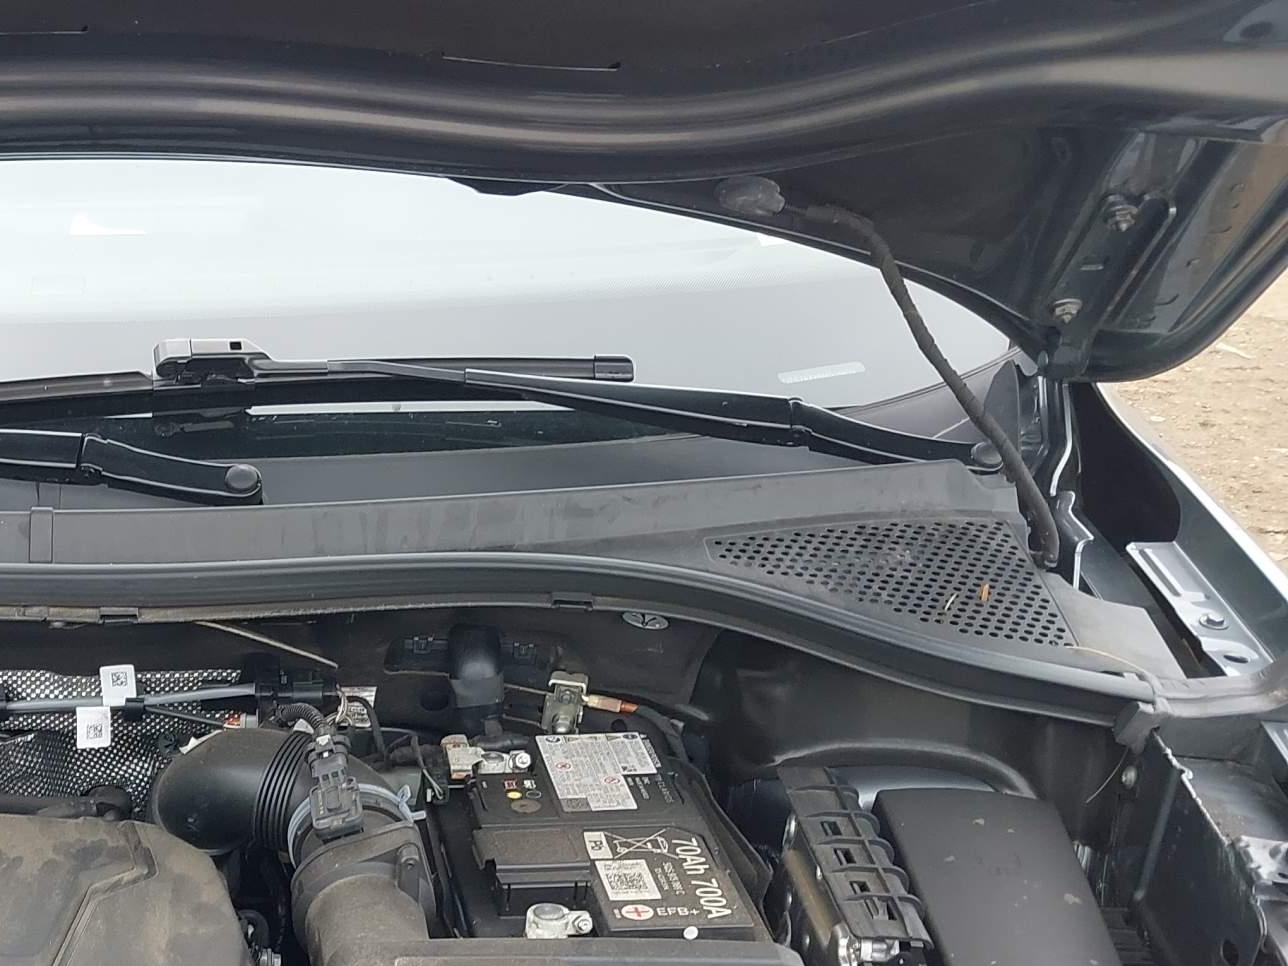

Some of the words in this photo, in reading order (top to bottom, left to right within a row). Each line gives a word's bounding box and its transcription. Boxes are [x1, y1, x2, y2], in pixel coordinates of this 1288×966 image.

[672, 837, 710, 875] 70Ah
[691, 878, 732, 920] 700A
[656, 907, 700, 916] EFB+
